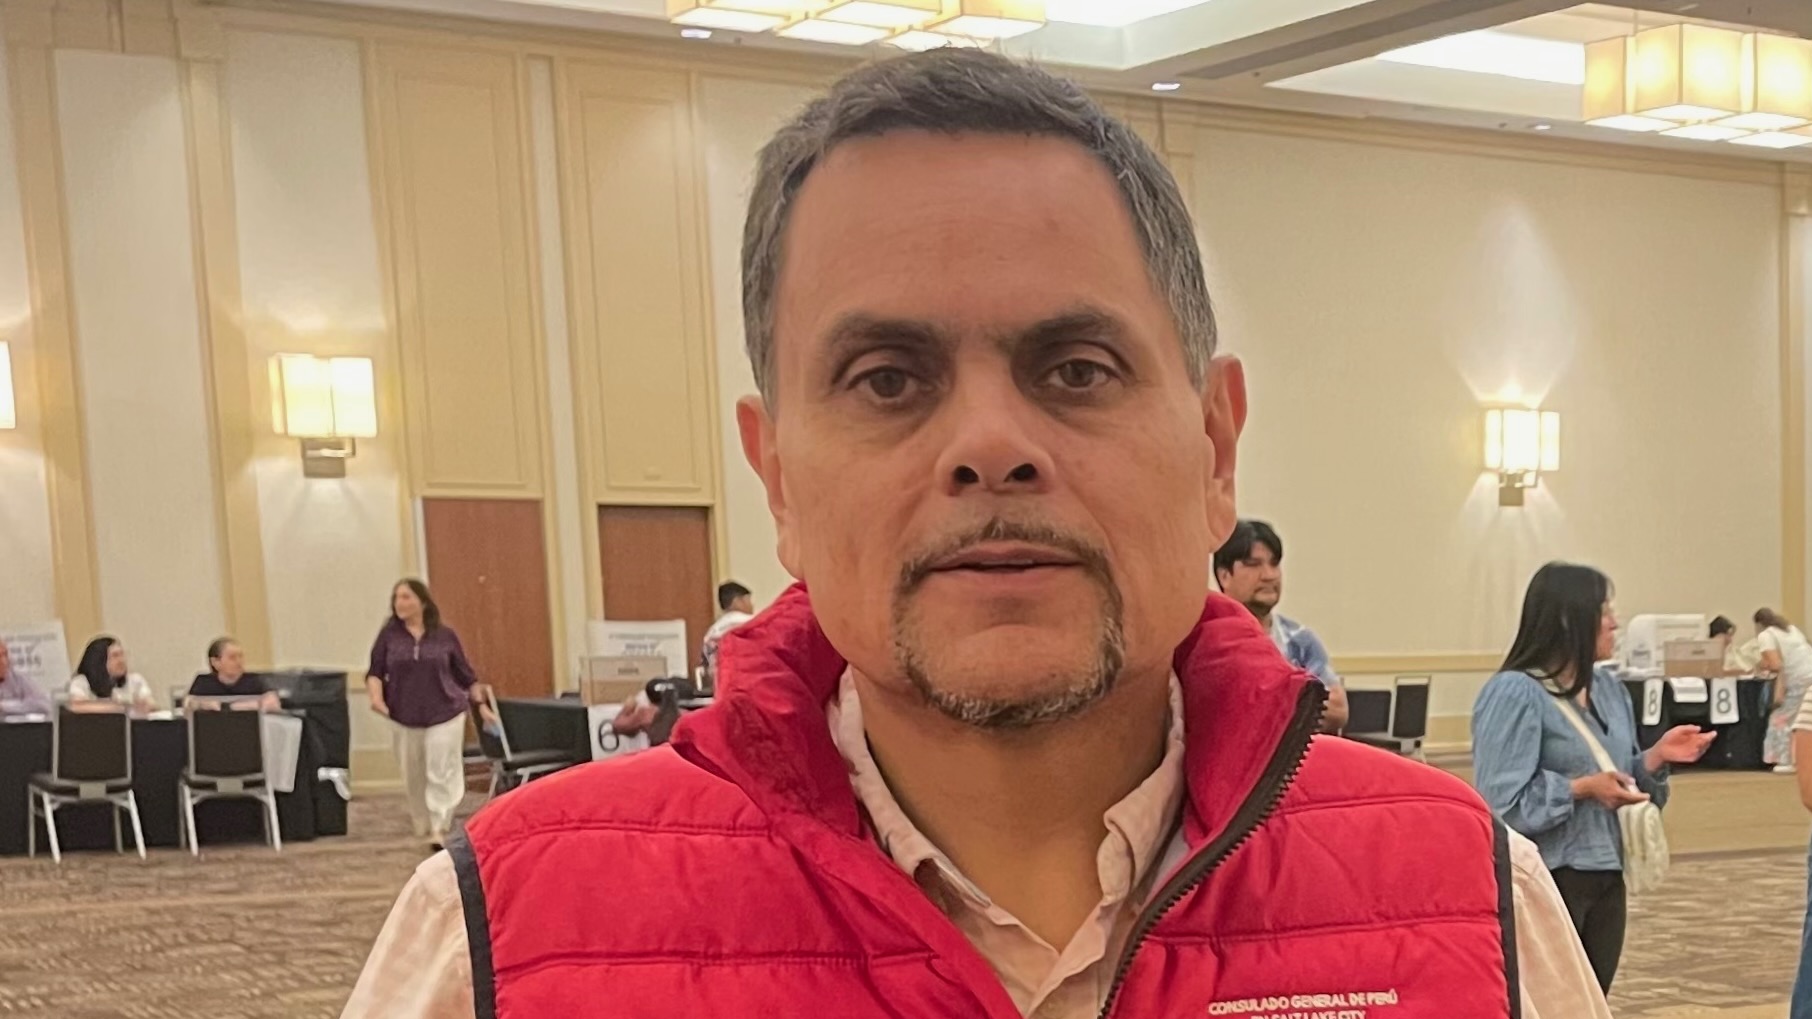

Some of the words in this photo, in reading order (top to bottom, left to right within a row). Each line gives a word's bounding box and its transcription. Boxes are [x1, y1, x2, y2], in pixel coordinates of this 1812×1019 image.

[1716, 688, 1732, 714] 8
[598, 719, 620, 752] 6
[1208, 995, 1290, 1015] CONSULADO
[1291, 992, 1349, 1008] GENERAL
[1348, 992, 1367, 1007] DE
